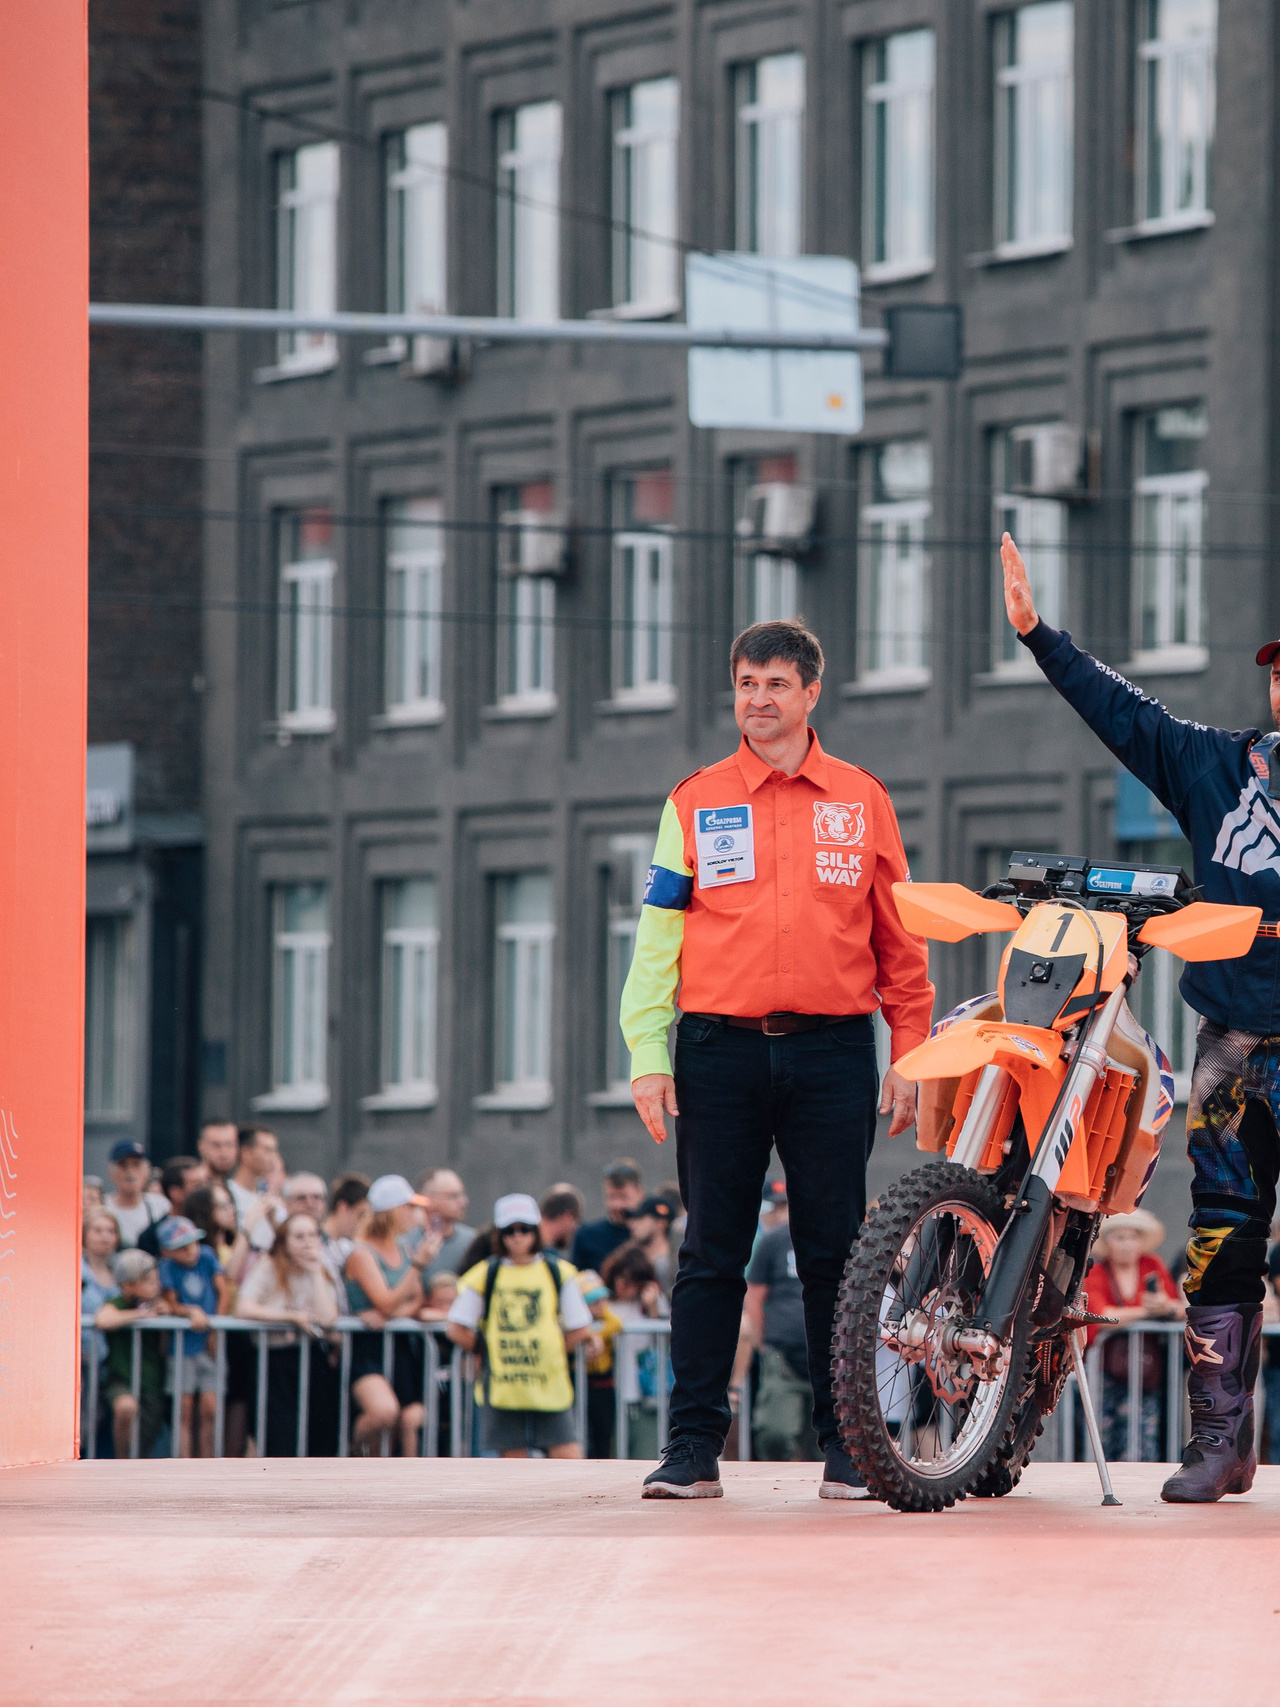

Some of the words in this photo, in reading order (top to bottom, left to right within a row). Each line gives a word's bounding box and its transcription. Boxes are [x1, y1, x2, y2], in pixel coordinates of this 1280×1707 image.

[815, 851, 863, 871] SILK
[815, 867, 863, 887] WAY
[1050, 912, 1075, 953] 1
[499, 1339, 539, 1350] SILK
